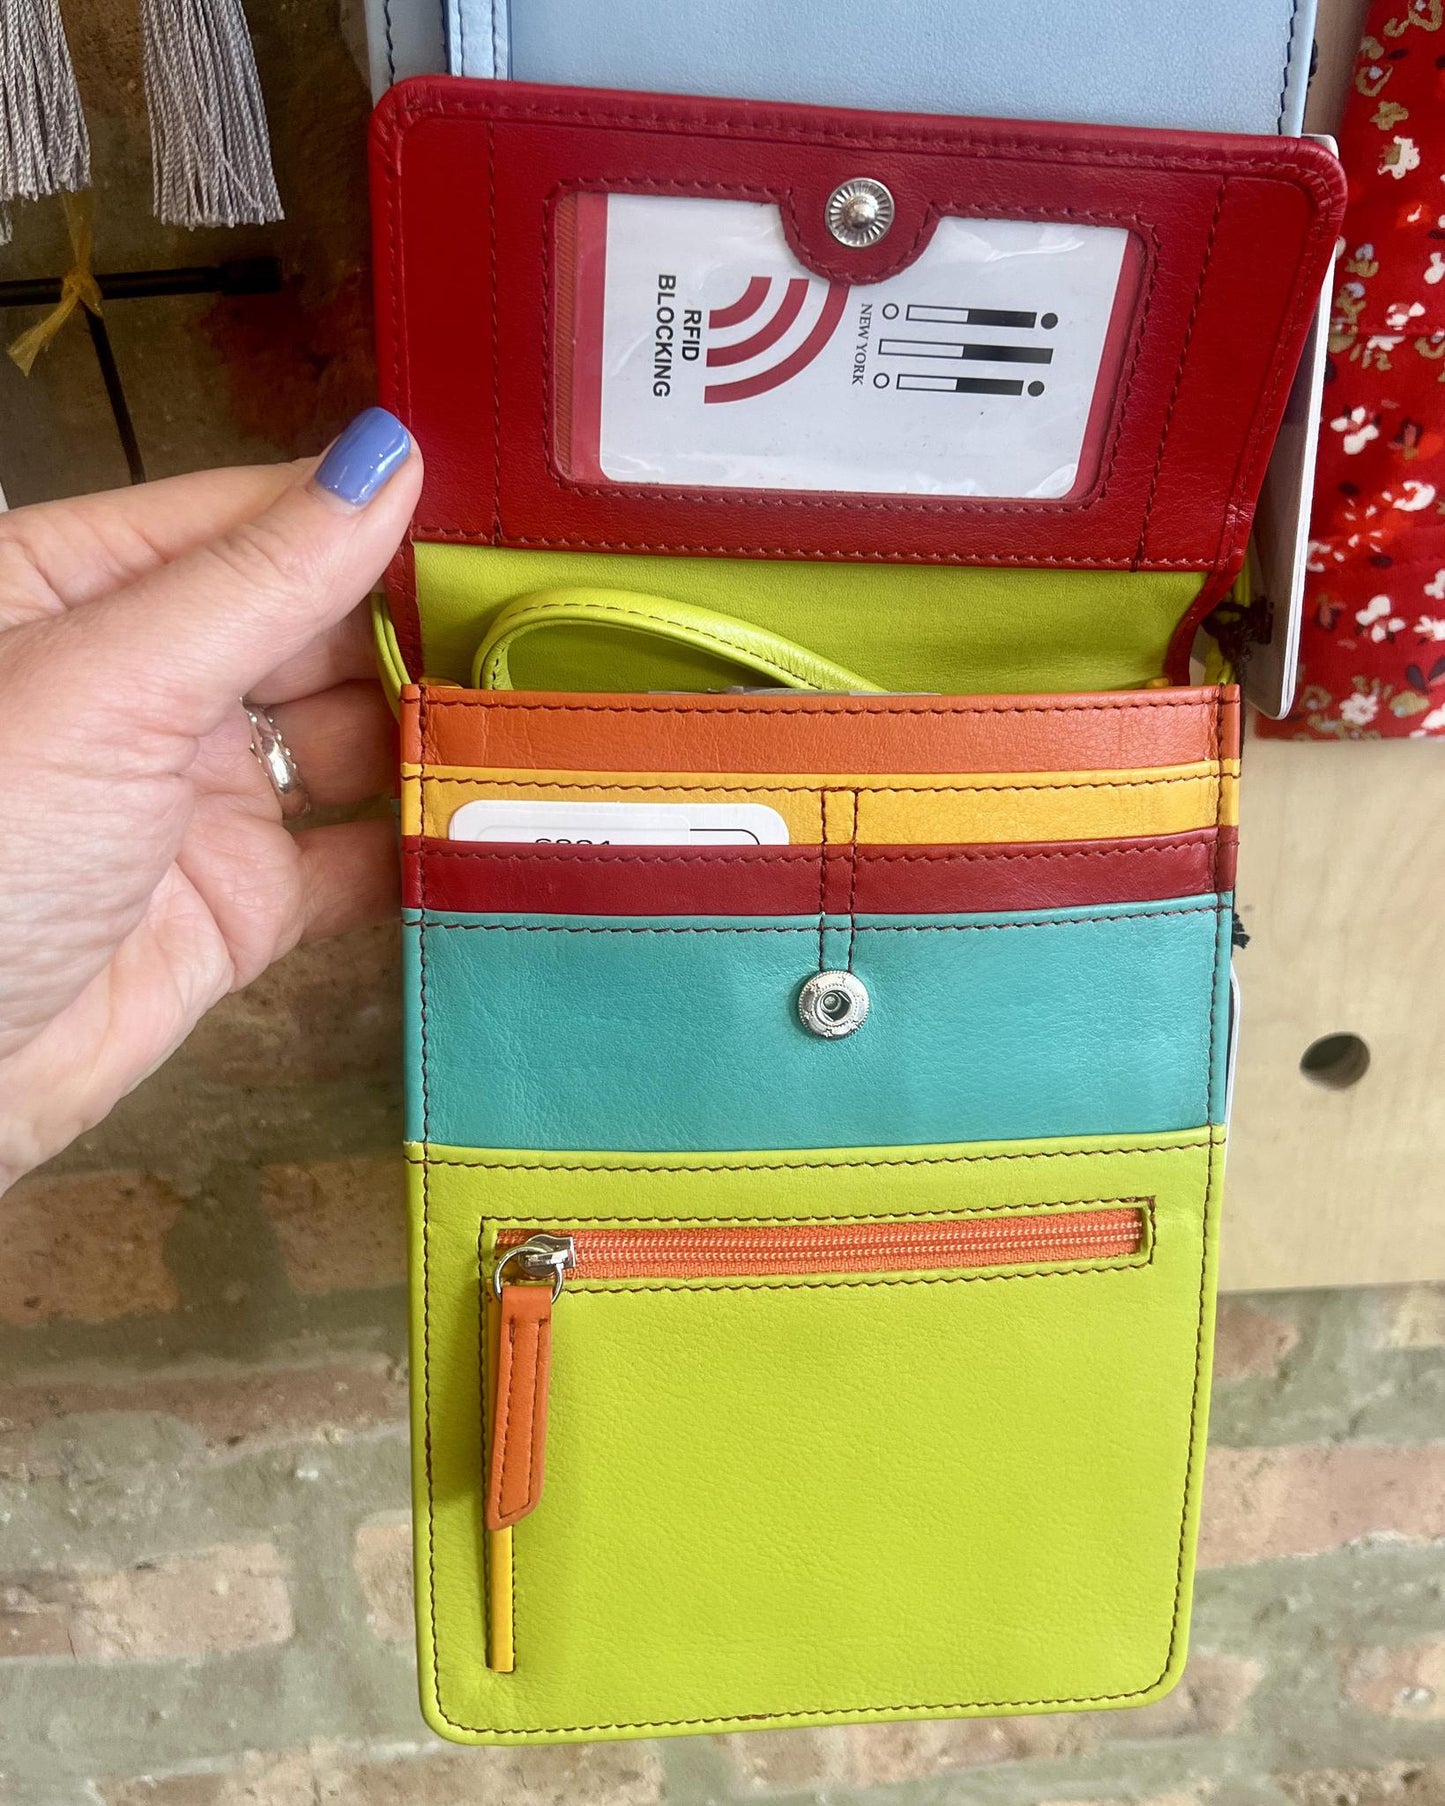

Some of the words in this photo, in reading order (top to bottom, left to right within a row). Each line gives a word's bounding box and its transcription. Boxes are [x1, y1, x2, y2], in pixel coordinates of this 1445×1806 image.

[653, 274, 676, 397] BLOCKING
[682, 309, 702, 361] RFID
[857, 303, 873, 340] NEW
[852, 342, 868, 385] YORK
